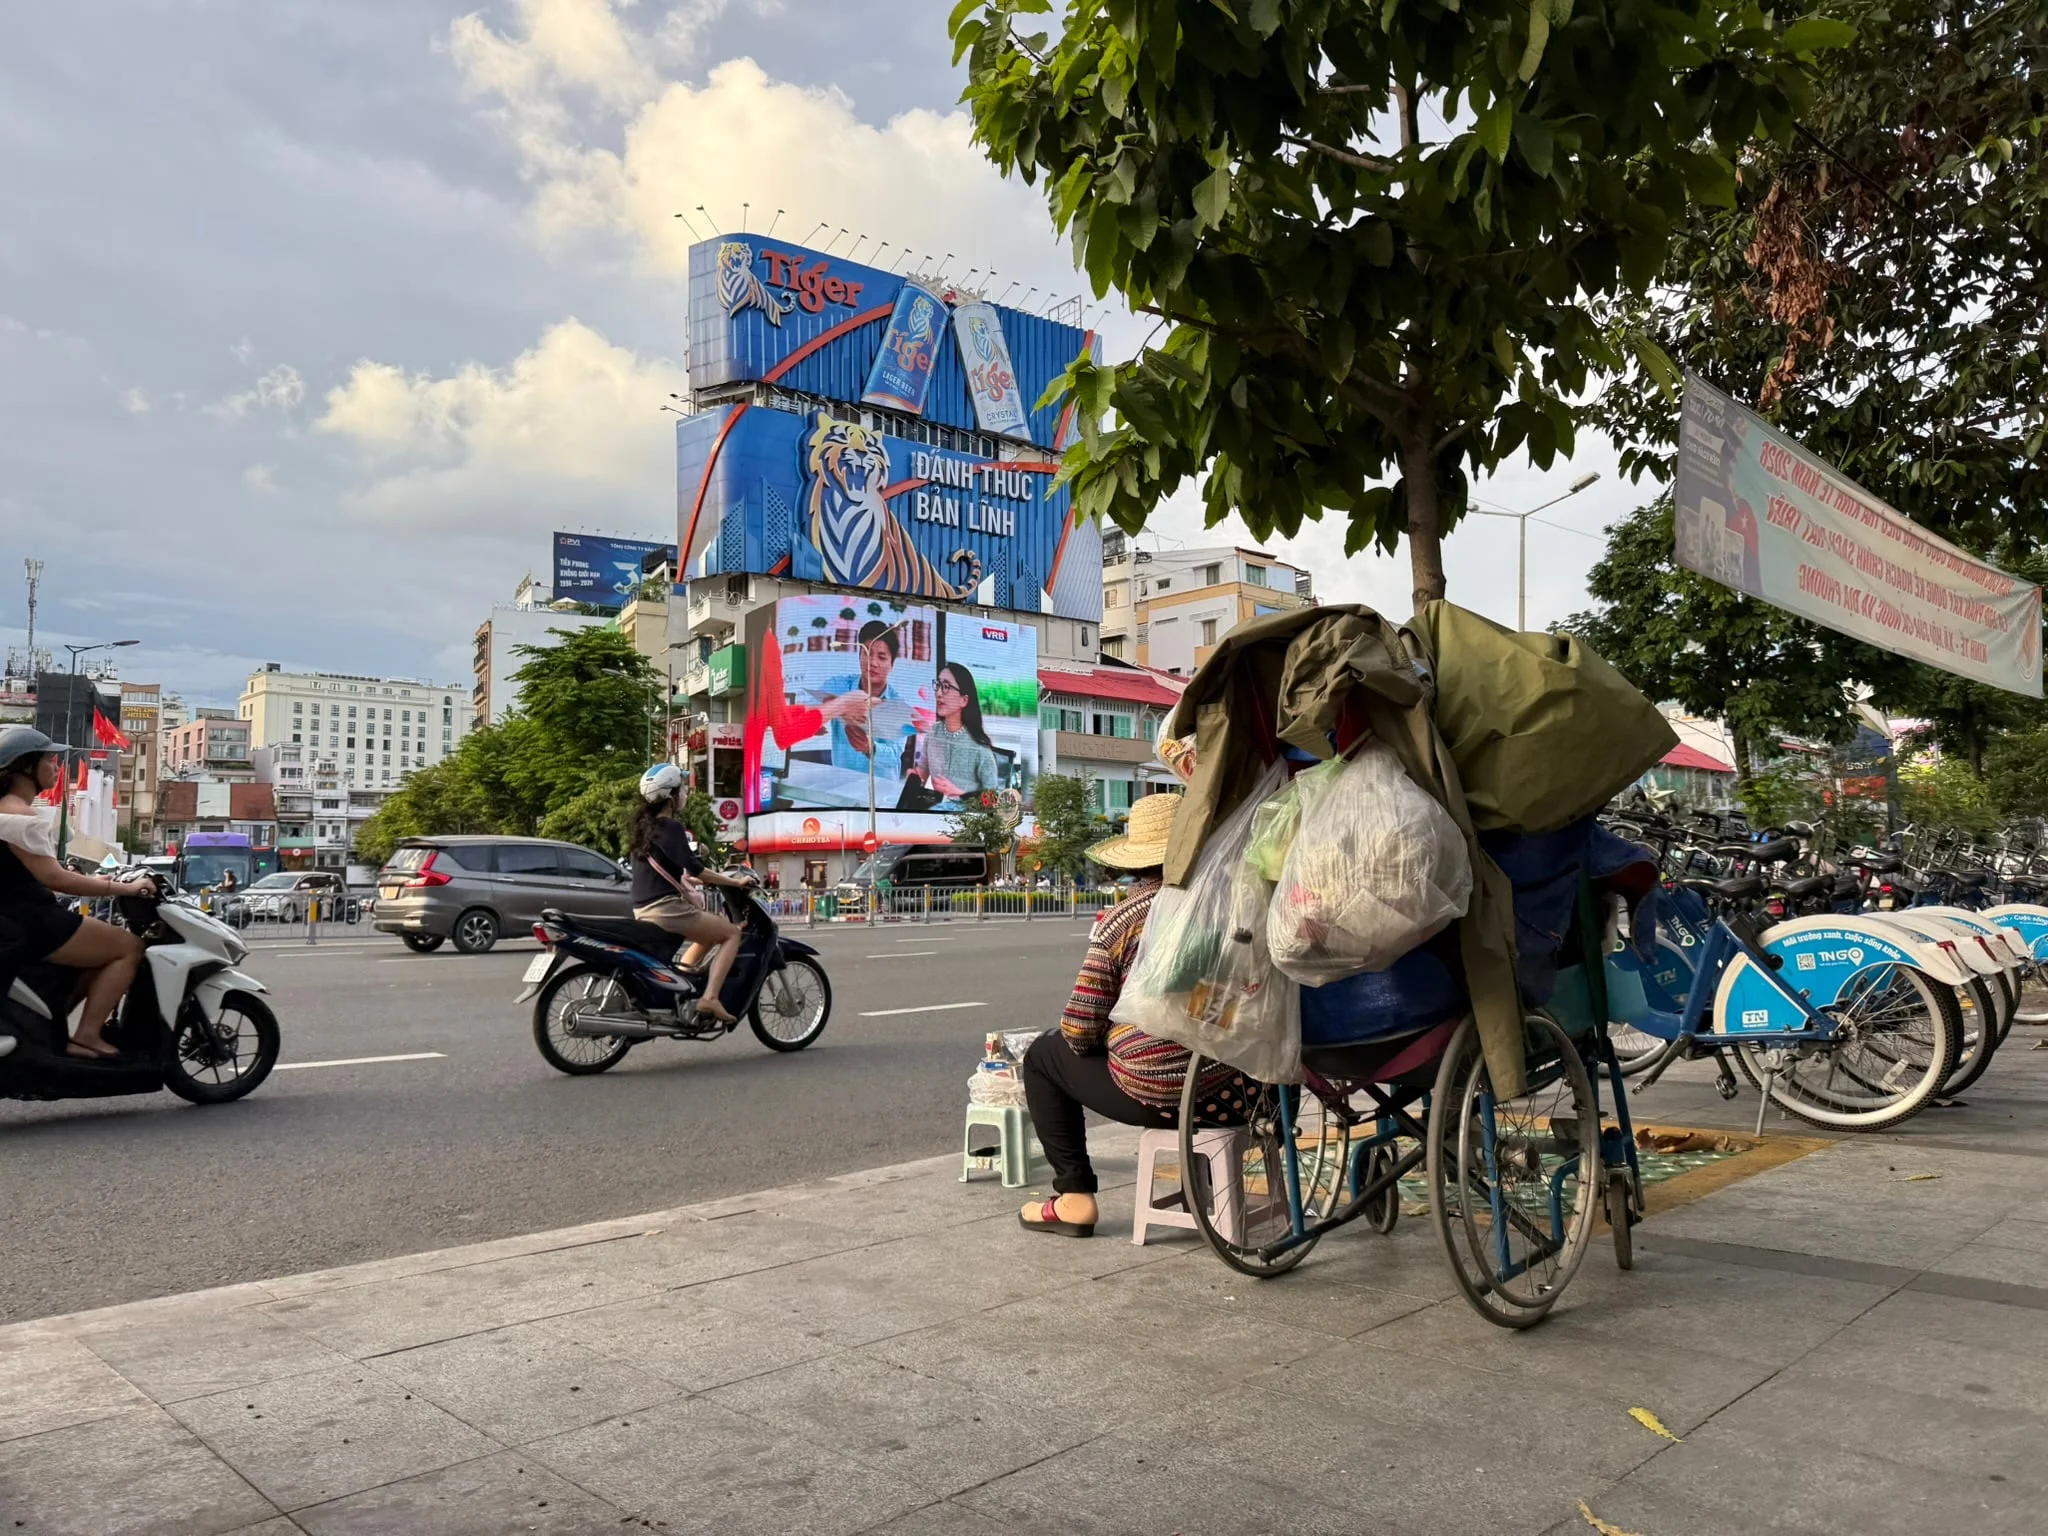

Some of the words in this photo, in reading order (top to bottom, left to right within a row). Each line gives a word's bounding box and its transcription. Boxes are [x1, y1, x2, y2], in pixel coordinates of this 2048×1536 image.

[762, 249, 864, 313] Tiger
[987, 409, 1017, 421] CRYSTAL
[917, 449, 973, 489] ĐÁNH
[981, 465, 1033, 501] THỨC
[917, 486, 959, 527] BẢN
[969, 499, 1014, 537] LĨNH
[985, 630, 1005, 640] VRB
